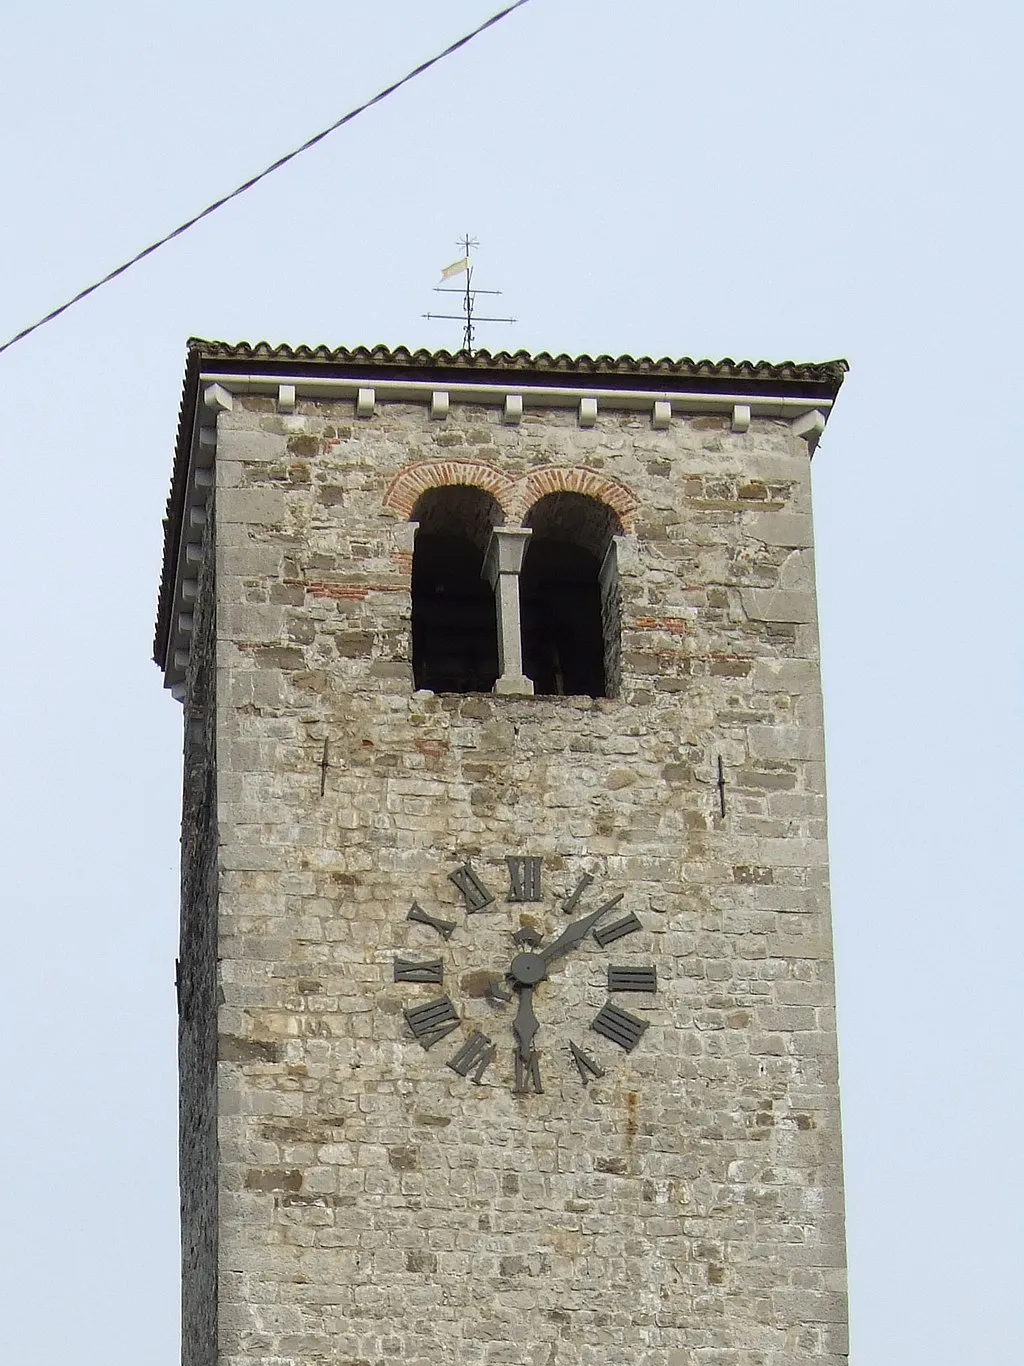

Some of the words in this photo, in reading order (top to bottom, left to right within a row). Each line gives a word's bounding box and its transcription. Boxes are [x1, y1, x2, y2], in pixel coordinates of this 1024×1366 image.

[447, 861, 495, 914] XI
[505, 855, 544, 902] XII
[562, 872, 594, 914] I
[406, 900, 457, 941] X
[593, 911, 643, 948] II
[394, 956, 444, 984] IX
[608, 963, 656, 993] III
[404, 994, 460, 1051] VIII
[589, 999, 650, 1053] IIII
[446, 1032, 497, 1084] VII
[569, 1039, 605, 1085] V
